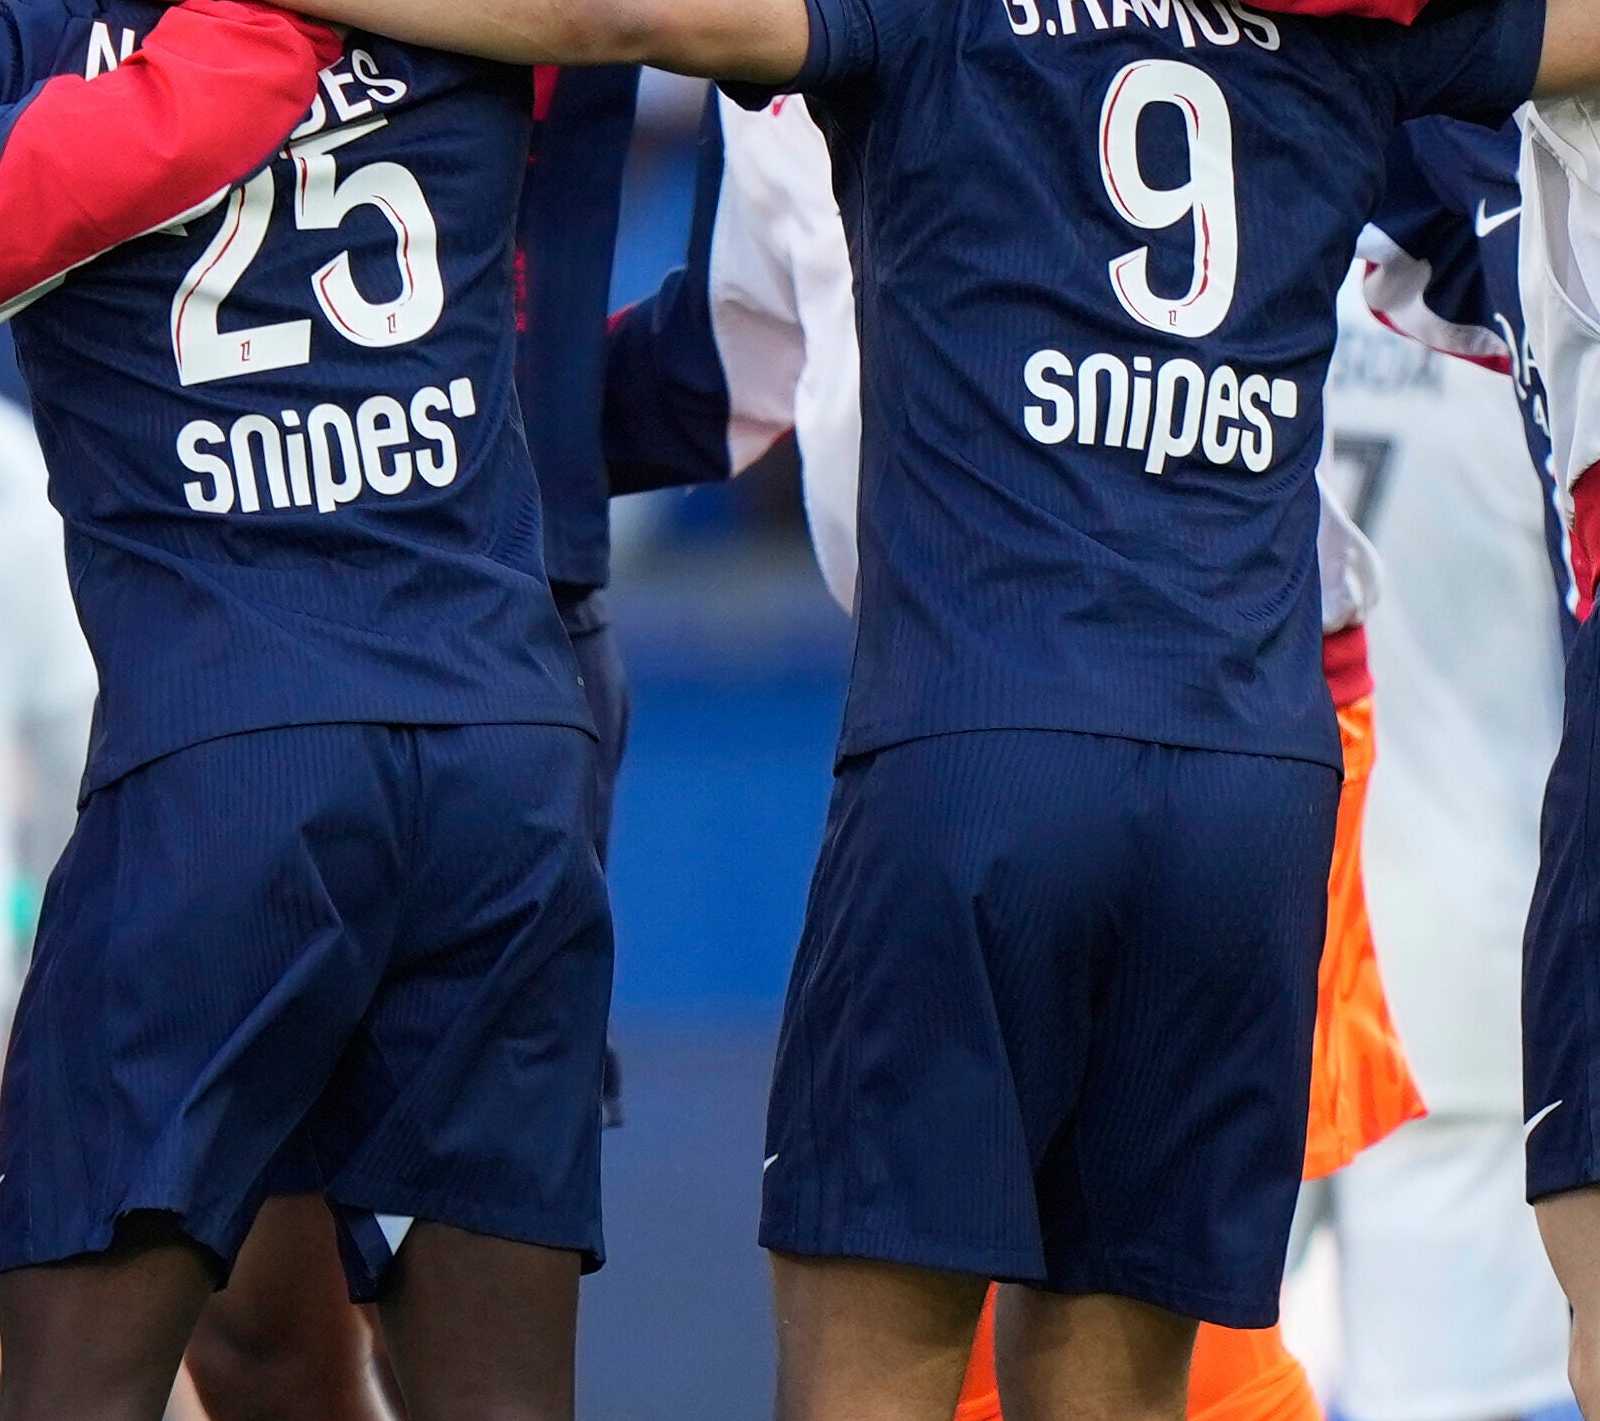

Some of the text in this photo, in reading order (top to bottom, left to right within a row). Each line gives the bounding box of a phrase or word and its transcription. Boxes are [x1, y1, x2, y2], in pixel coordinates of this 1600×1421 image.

[160, 118, 444, 387] 25
[1099, 59, 1238, 338] 9
[177, 394, 459, 514] snipes
[1023, 350, 1275, 475] snipes
